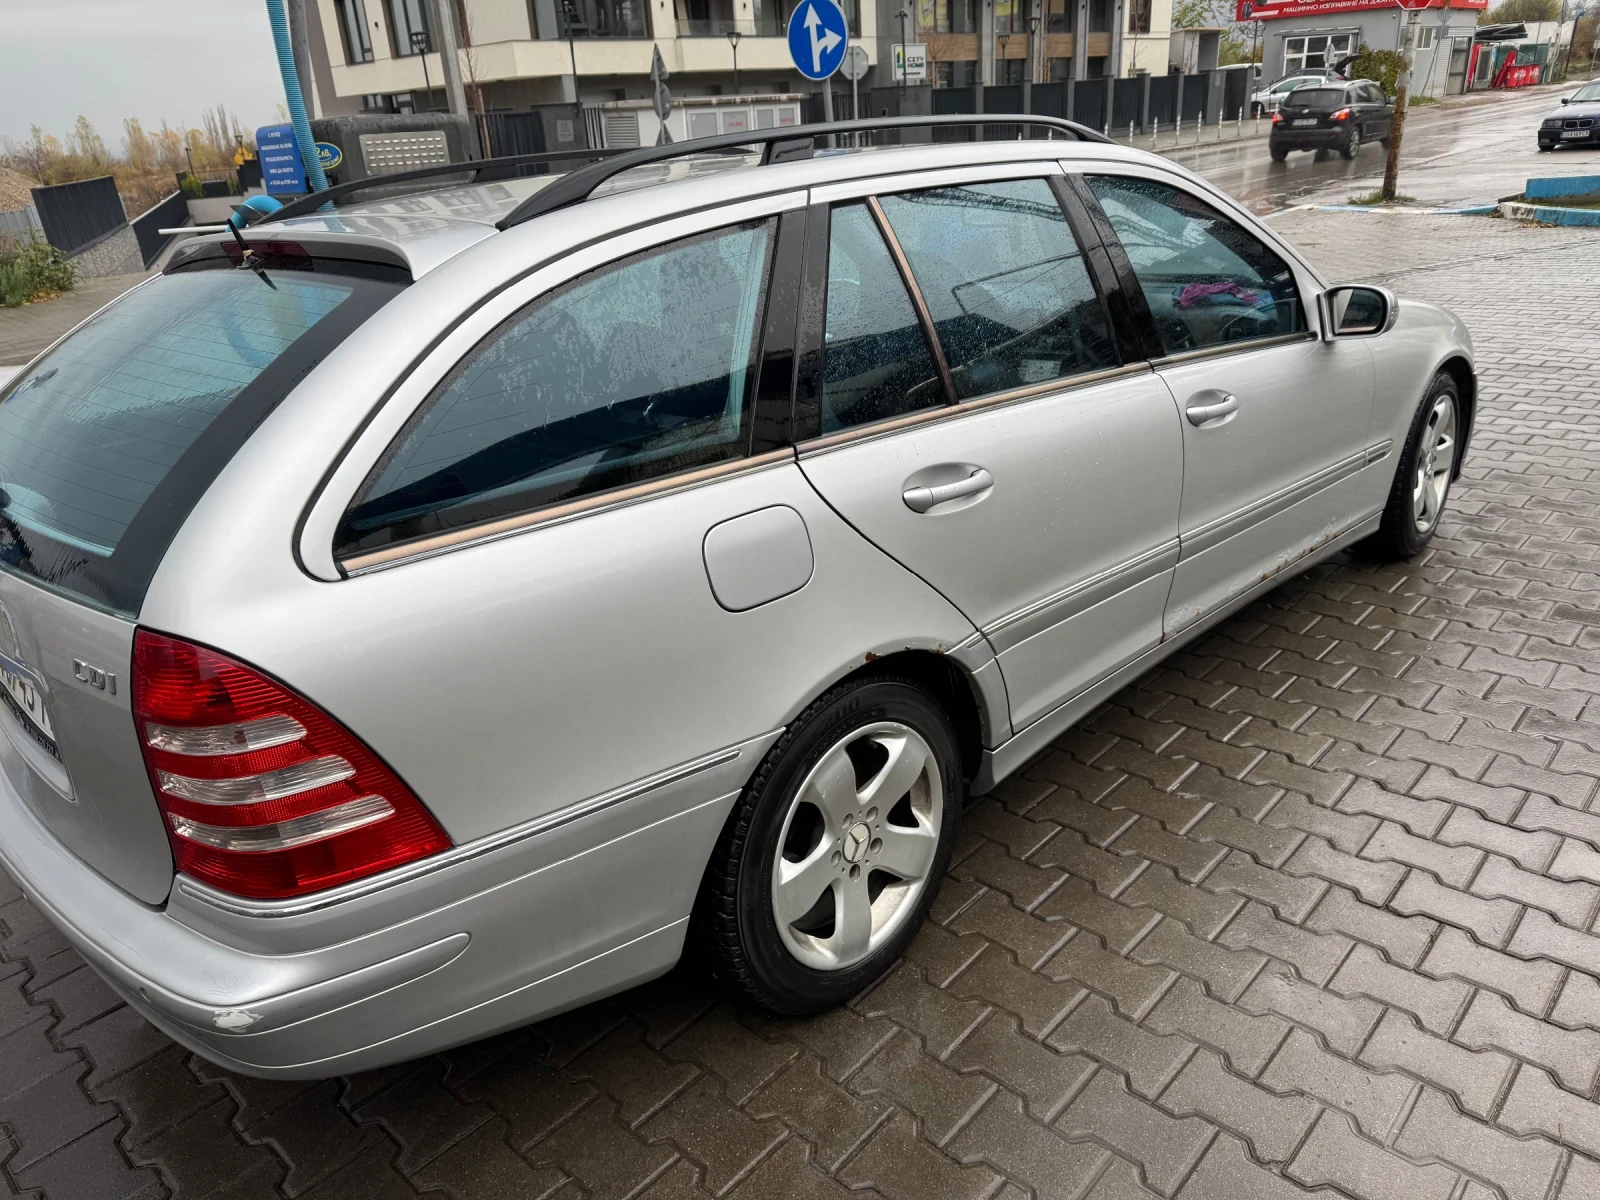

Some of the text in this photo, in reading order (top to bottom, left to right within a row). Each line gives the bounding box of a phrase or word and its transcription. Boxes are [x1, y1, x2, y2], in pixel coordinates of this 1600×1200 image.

[1282, 4, 1318, 13] МАШИННО
[1319, 1, 1357, 10] ИЗПРАВЯНЕ
[73, 658, 117, 696] CDI
